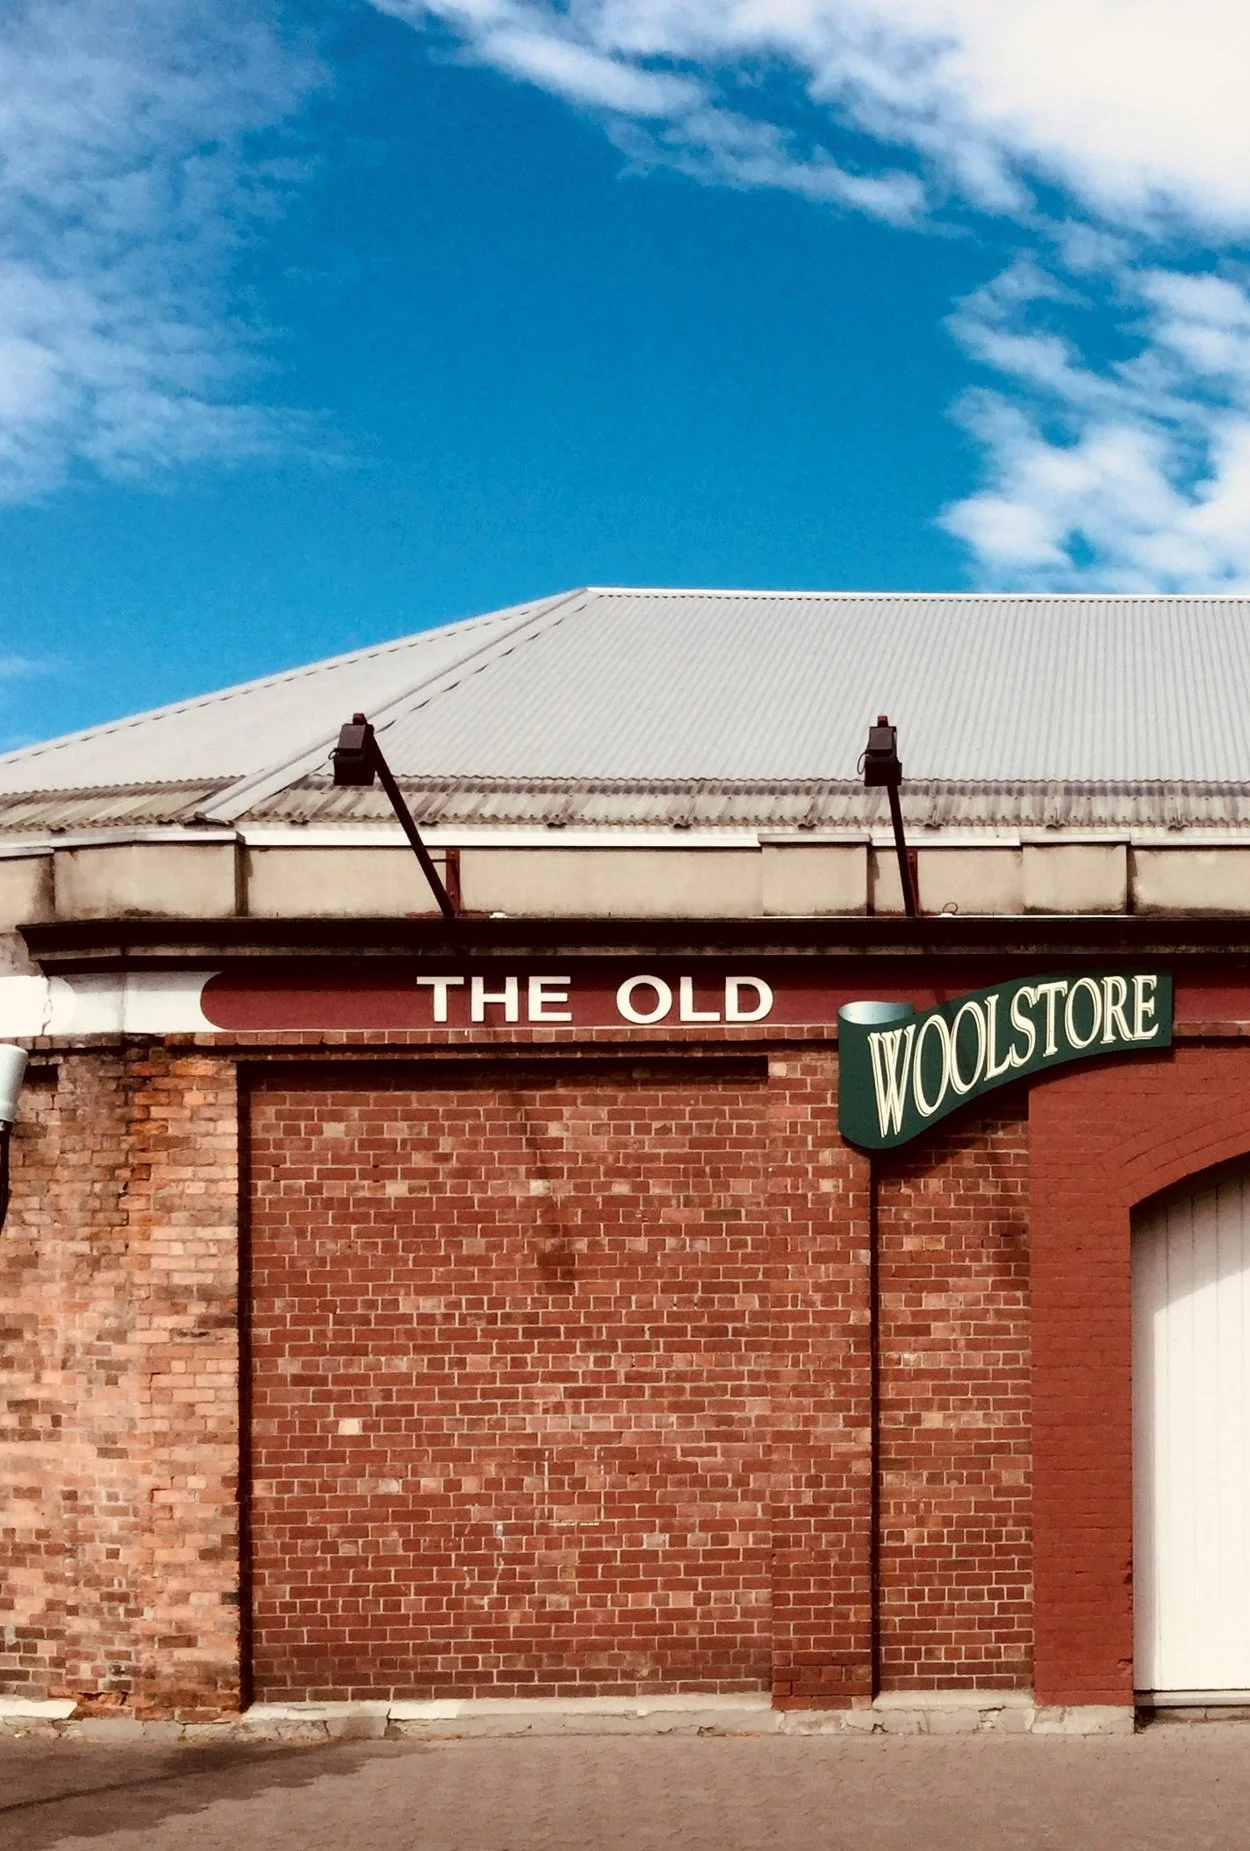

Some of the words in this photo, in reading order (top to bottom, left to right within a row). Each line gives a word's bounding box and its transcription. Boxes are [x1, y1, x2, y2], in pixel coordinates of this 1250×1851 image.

[417, 976, 572, 1022] THE
[617, 975, 773, 1023] OLD
[867, 974, 1160, 1139] WOOLSTORE
